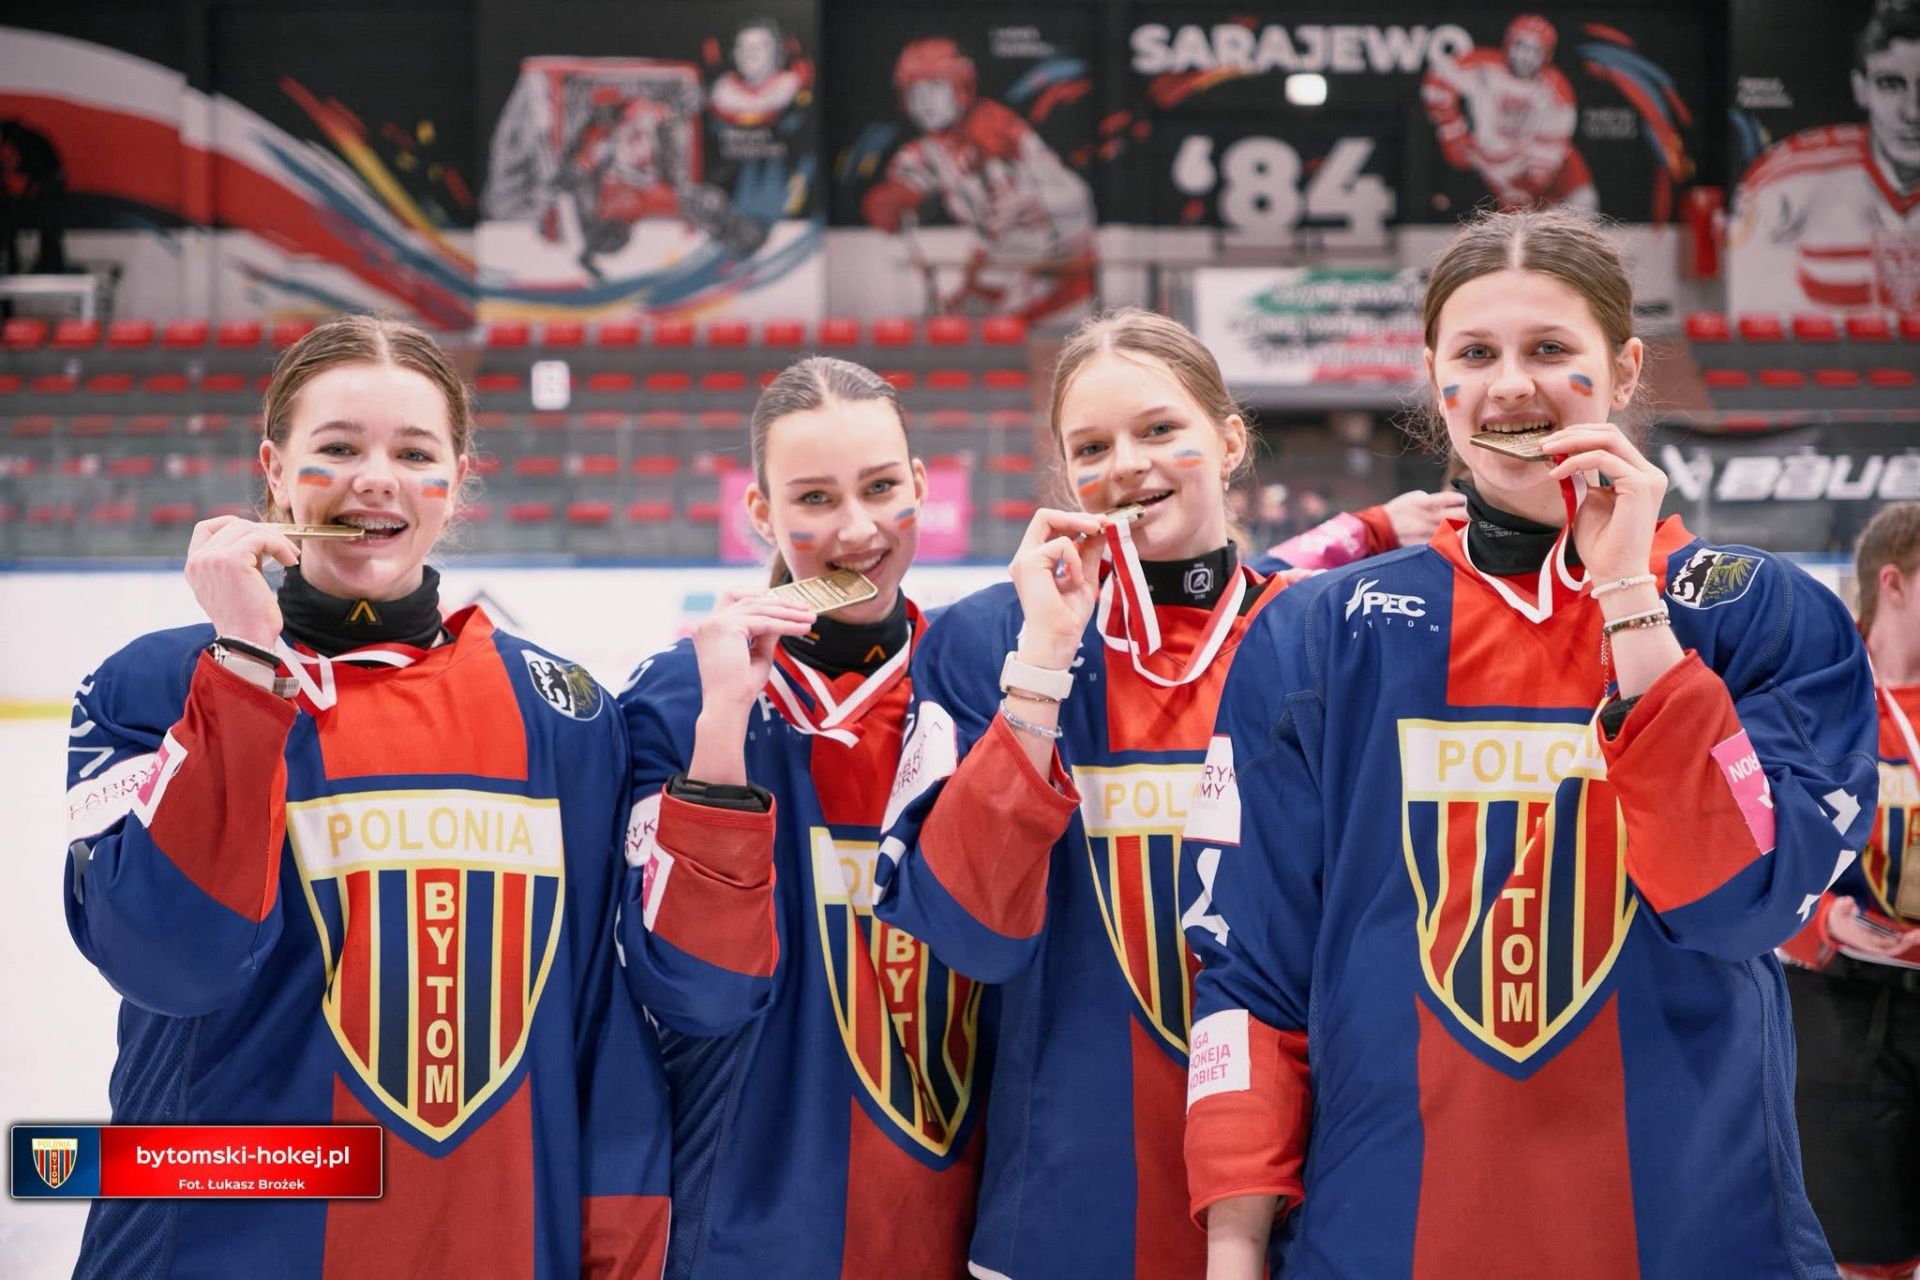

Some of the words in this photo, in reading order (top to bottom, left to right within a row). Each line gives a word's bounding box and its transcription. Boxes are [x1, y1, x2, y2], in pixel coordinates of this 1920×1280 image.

[1130, 24, 1474, 74] SARAJEWO
[1363, 592, 1425, 617] PEC
[327, 807, 533, 857] POLONIA
[424, 883, 455, 1104] BYTOM
[1191, 1044, 1231, 1069] OKEJA
